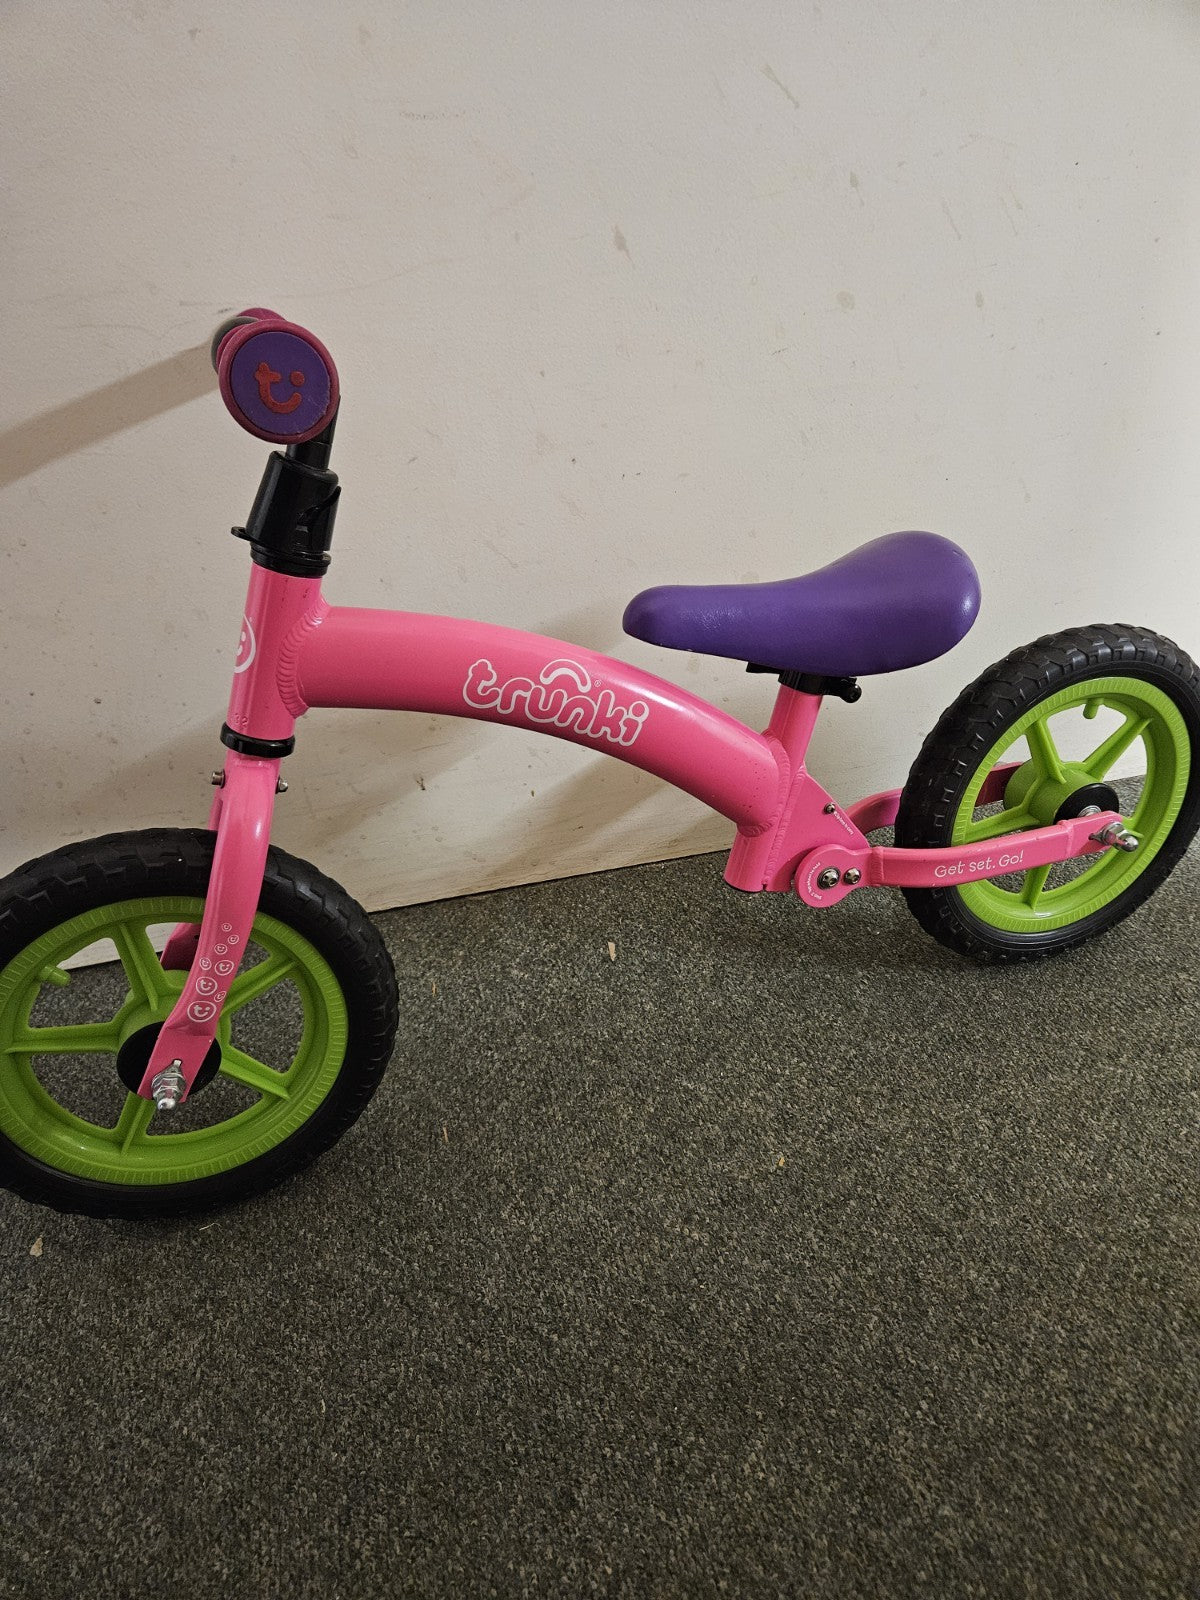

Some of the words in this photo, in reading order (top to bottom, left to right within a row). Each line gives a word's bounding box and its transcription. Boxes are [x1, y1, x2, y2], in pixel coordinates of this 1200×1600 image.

[462, 658, 650, 747] trunki
[934, 861, 966, 878] Get
[969, 857, 996, 873] set.
[998, 850, 1025, 868] Go!
